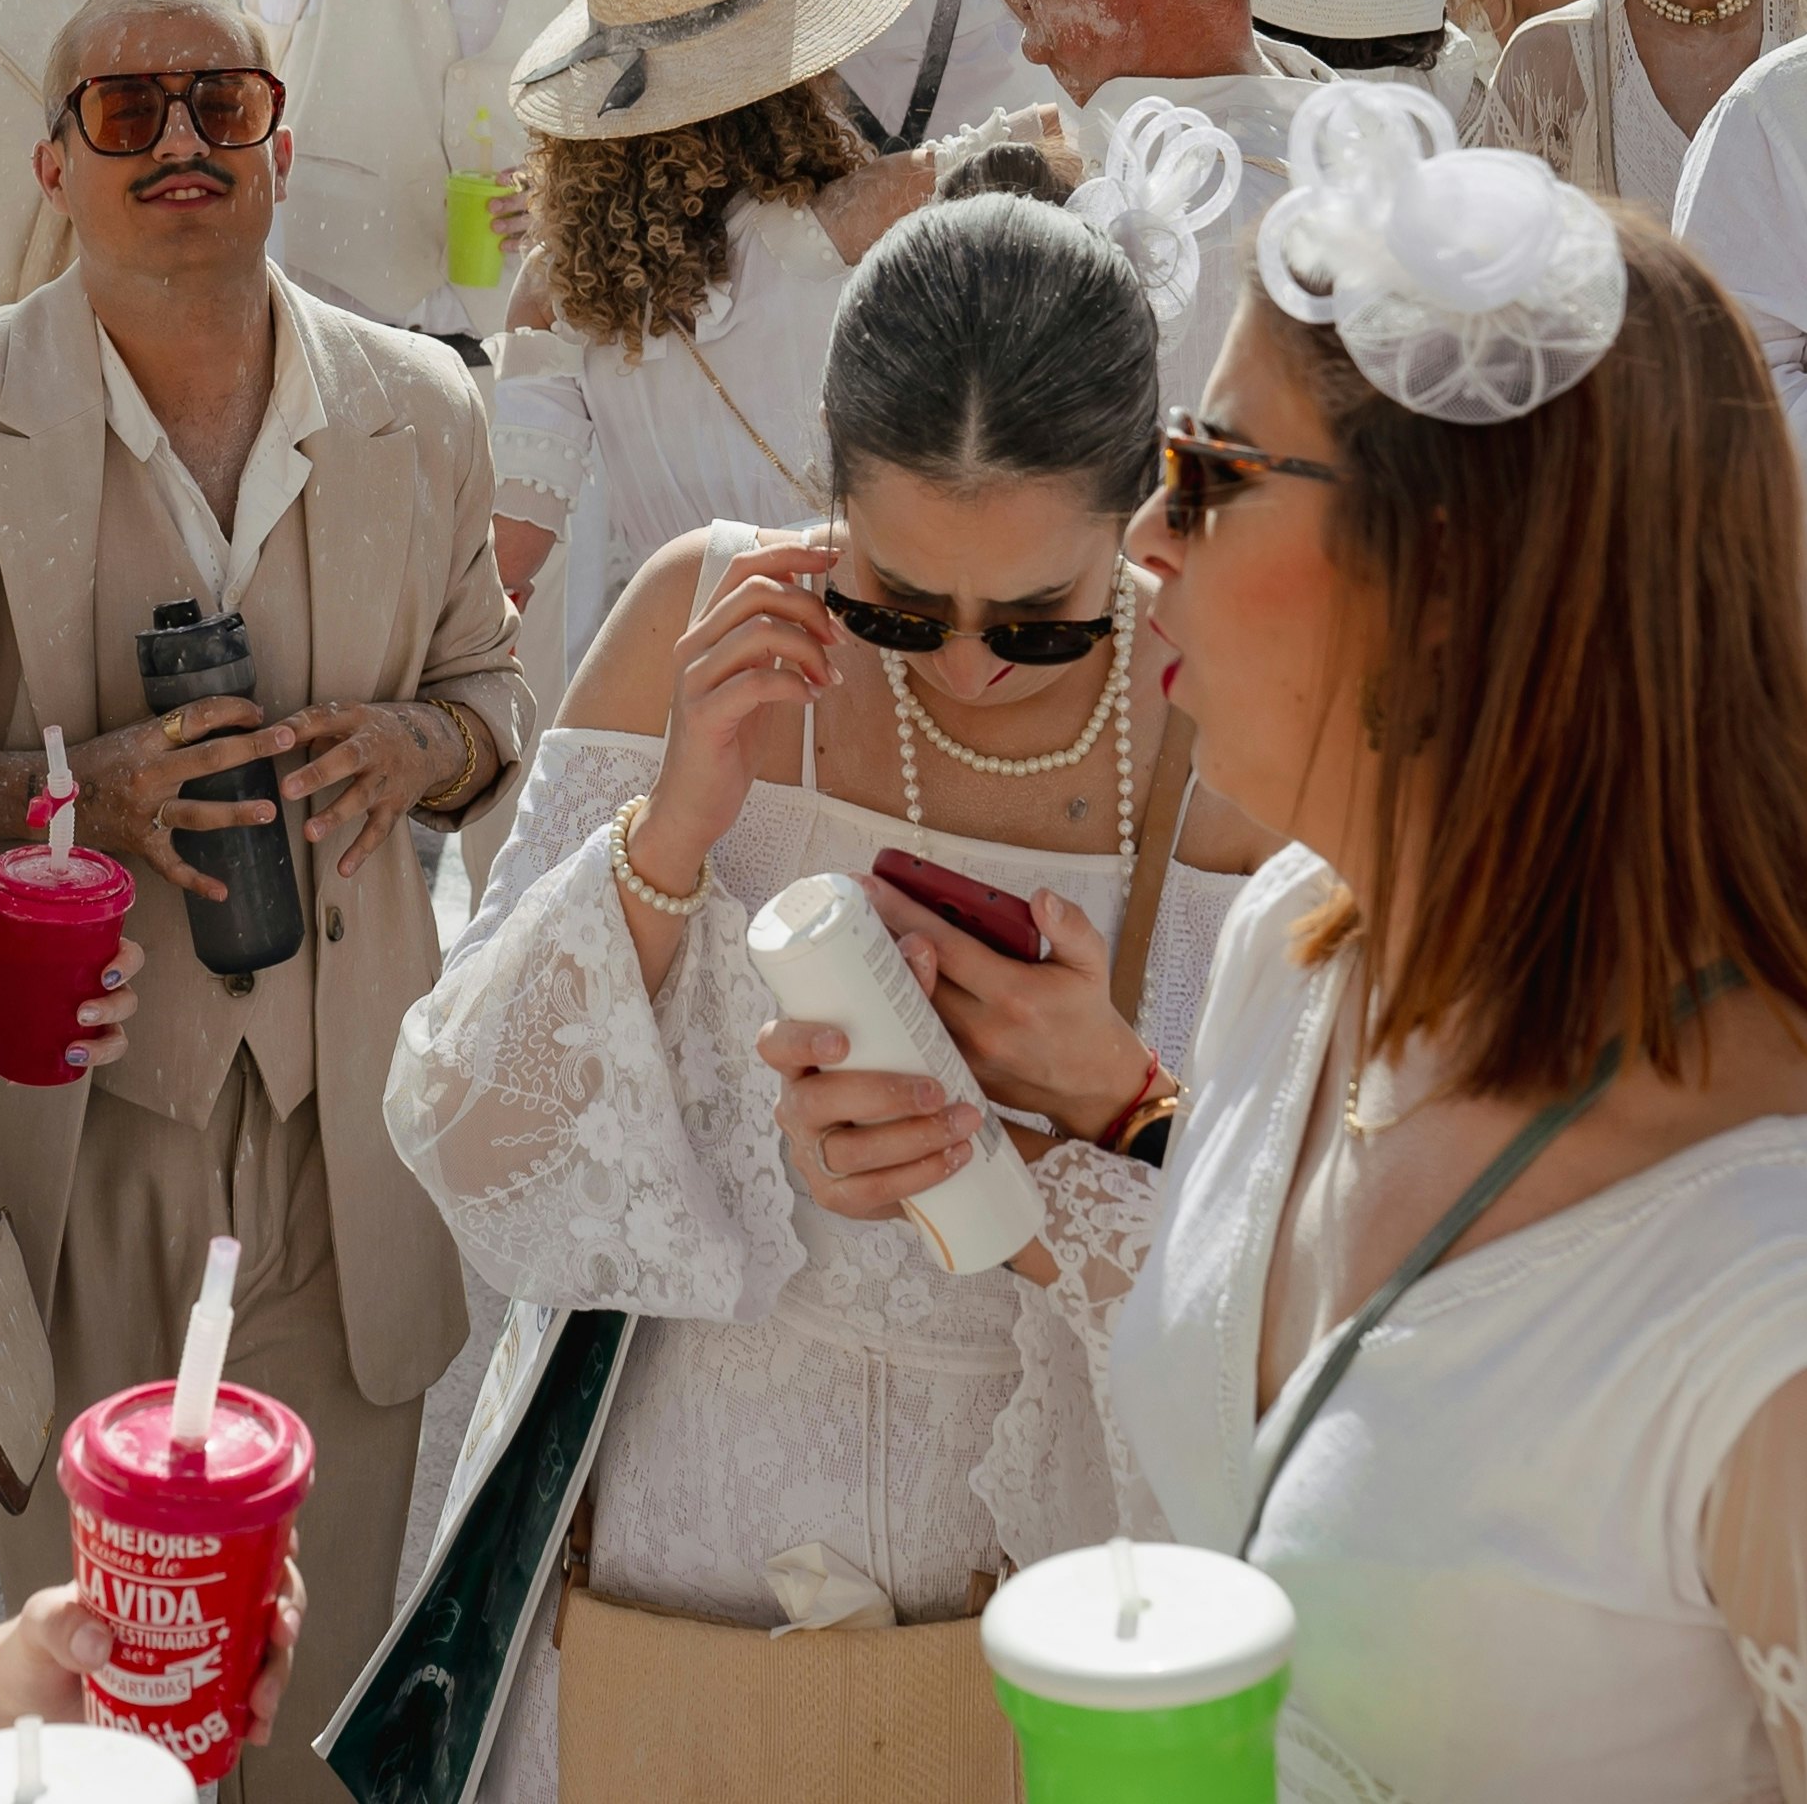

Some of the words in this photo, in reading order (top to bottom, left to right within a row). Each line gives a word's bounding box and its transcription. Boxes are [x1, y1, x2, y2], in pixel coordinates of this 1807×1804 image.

[101, 1518, 222, 1559] MEJORES
[89, 1539, 146, 1574] cosas
[152, 1556, 183, 1577] de
[78, 1553, 109, 1612] LA
[111, 1577, 205, 1627] VIDA
[109, 1621, 210, 1651] DESTINADAS
[121, 1647, 159, 1667] ser
